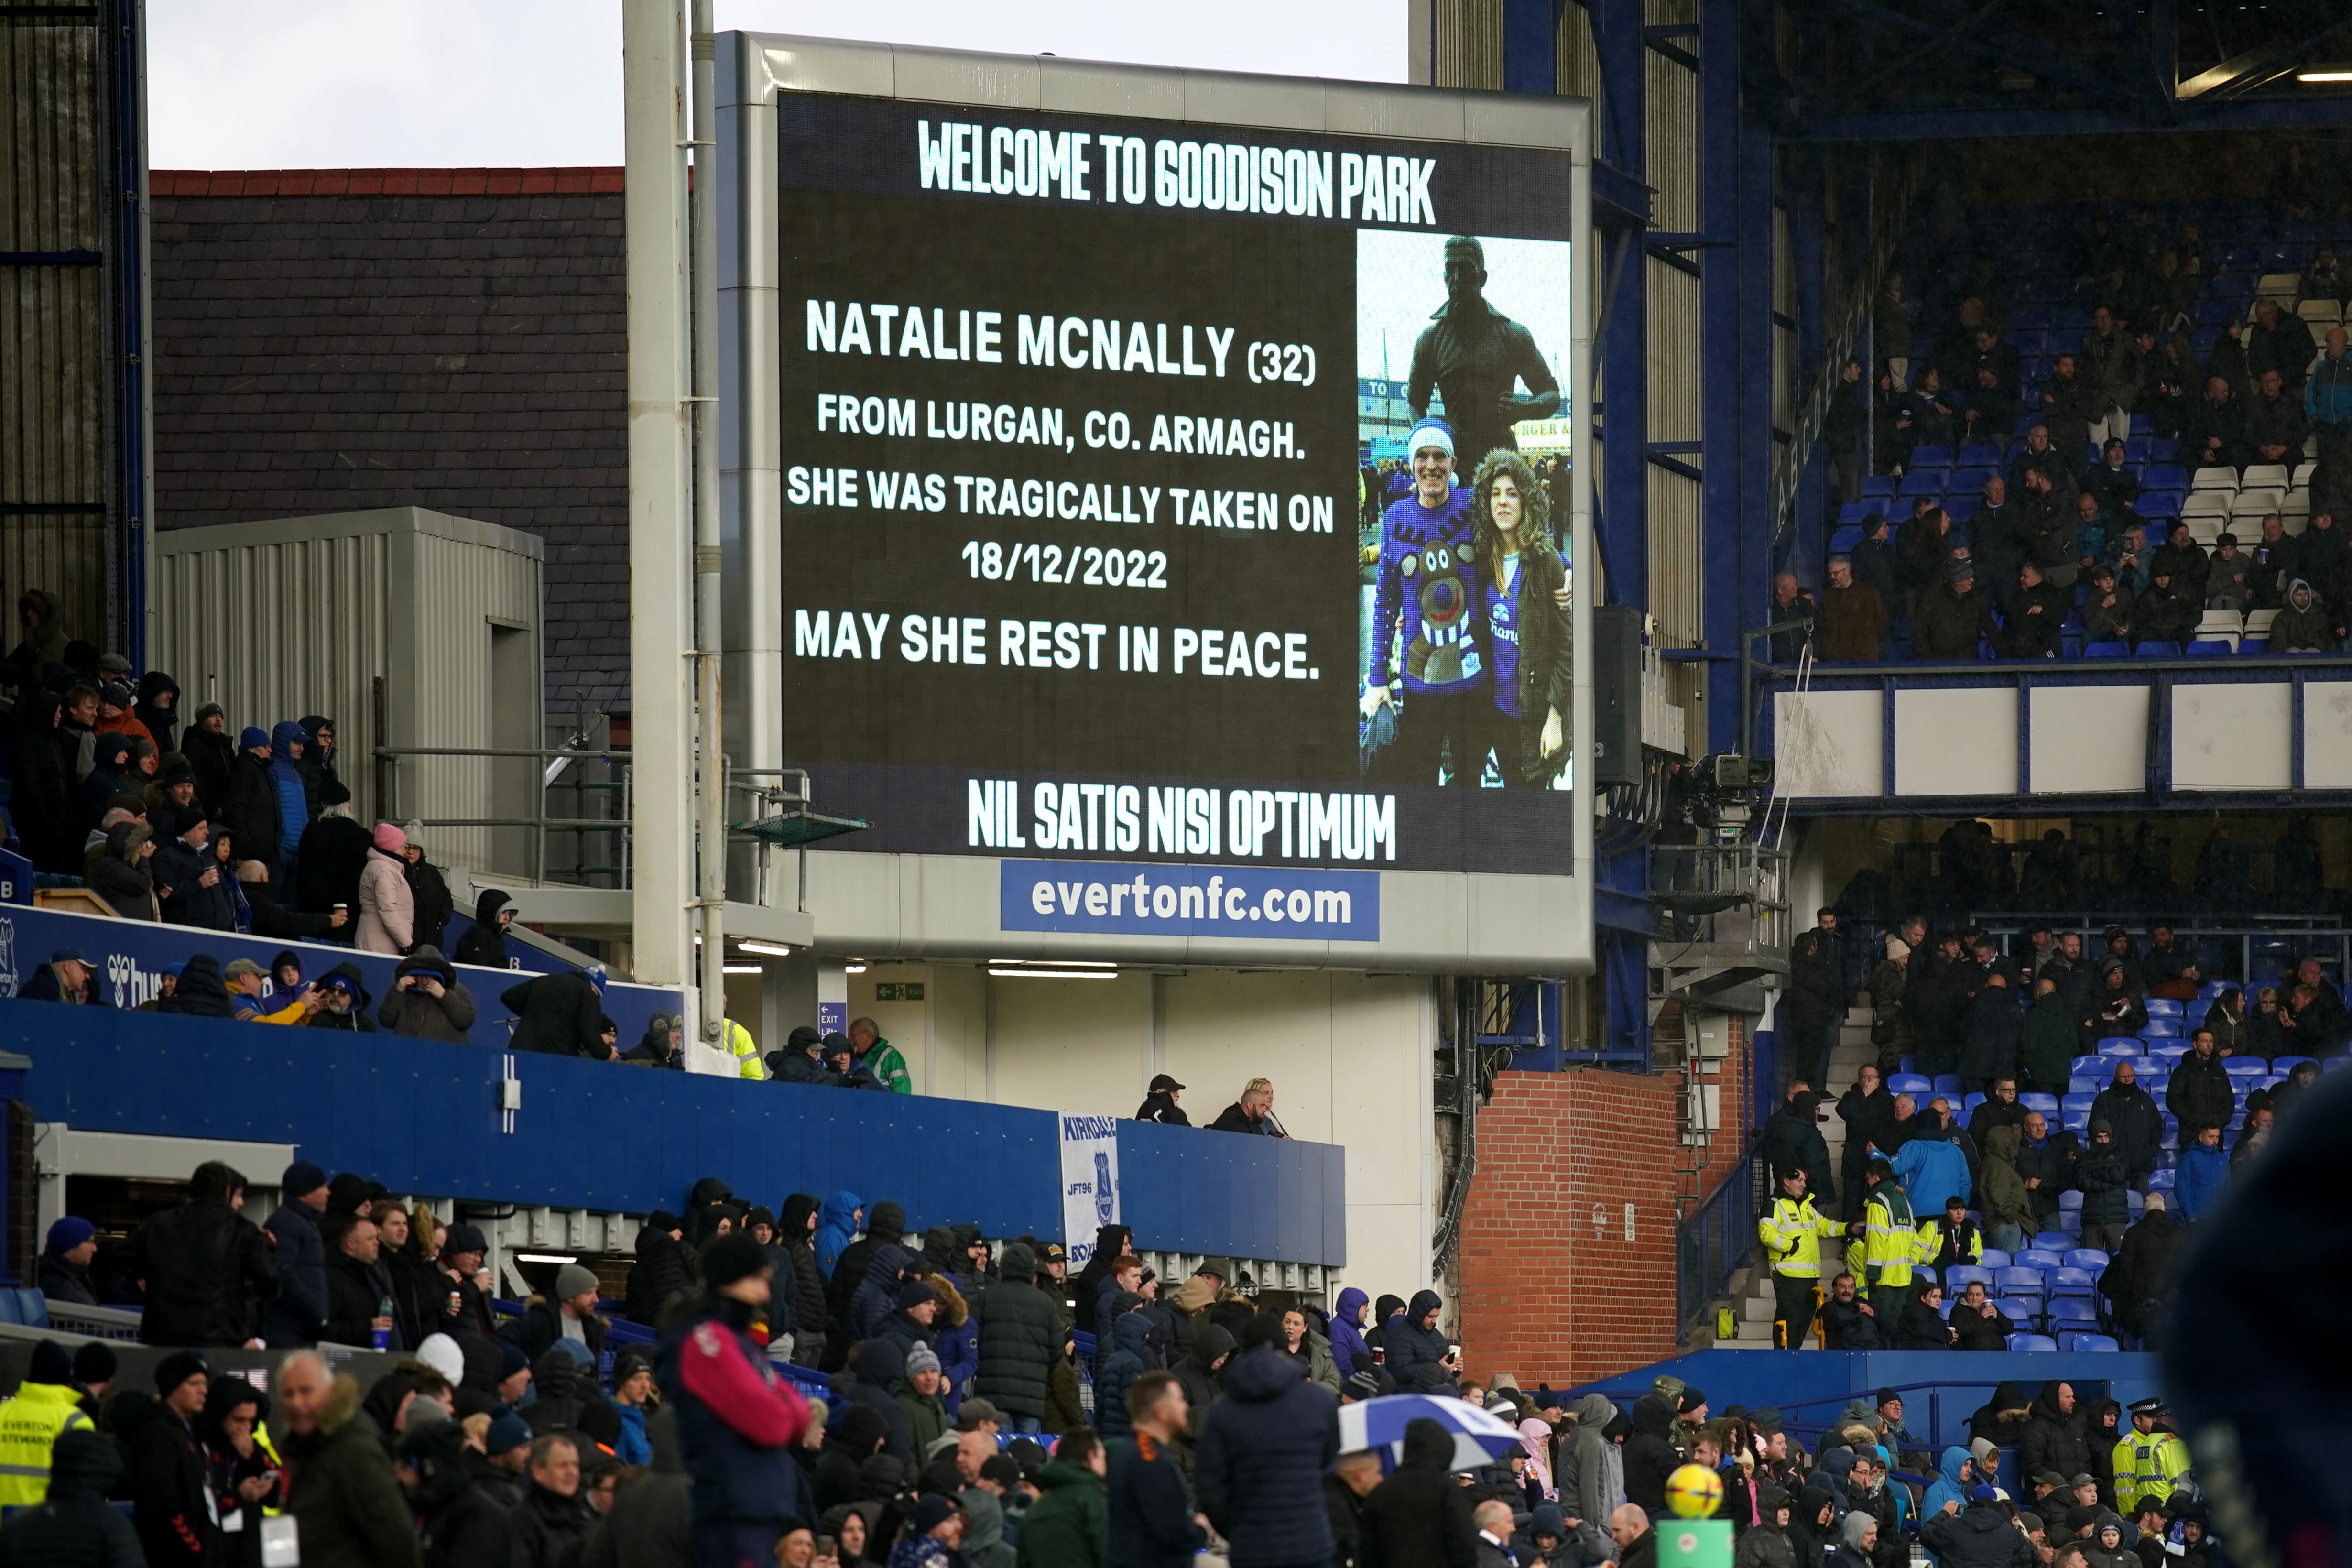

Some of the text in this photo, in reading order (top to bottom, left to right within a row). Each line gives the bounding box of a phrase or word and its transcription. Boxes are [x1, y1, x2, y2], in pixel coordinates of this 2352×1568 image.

[918, 121, 1436, 224] WELCOME TO GOODISON PARK
[807, 300, 1315, 386] NATALIE MCNALLY (32)
[1369, 382, 1387, 396] TO
[1815, 388, 1820, 441] D
[819, 394, 1305, 459] FROM LURGAN, CO. ARMAGH.
[1803, 417, 1809, 466] C
[1791, 440, 1798, 498] B
[788, 467, 1332, 533] SHE WAS TRAGICALLY TAKEN ON
[1777, 476, 1786, 529] A
[962, 542, 1166, 588] 18/12/2022
[796, 610, 1319, 679] MAY SHE REST IN PEACE.
[969, 780, 1395, 860] NIL SATIS NISI OPTIMUM
[1032, 874, 1351, 923] evertonfc.com
[1063, 1116, 1116, 1141] KIRKDALE
[1068, 1182, 1092, 1196] JFT96
[3, 1420, 54, 1432] EVERTON
